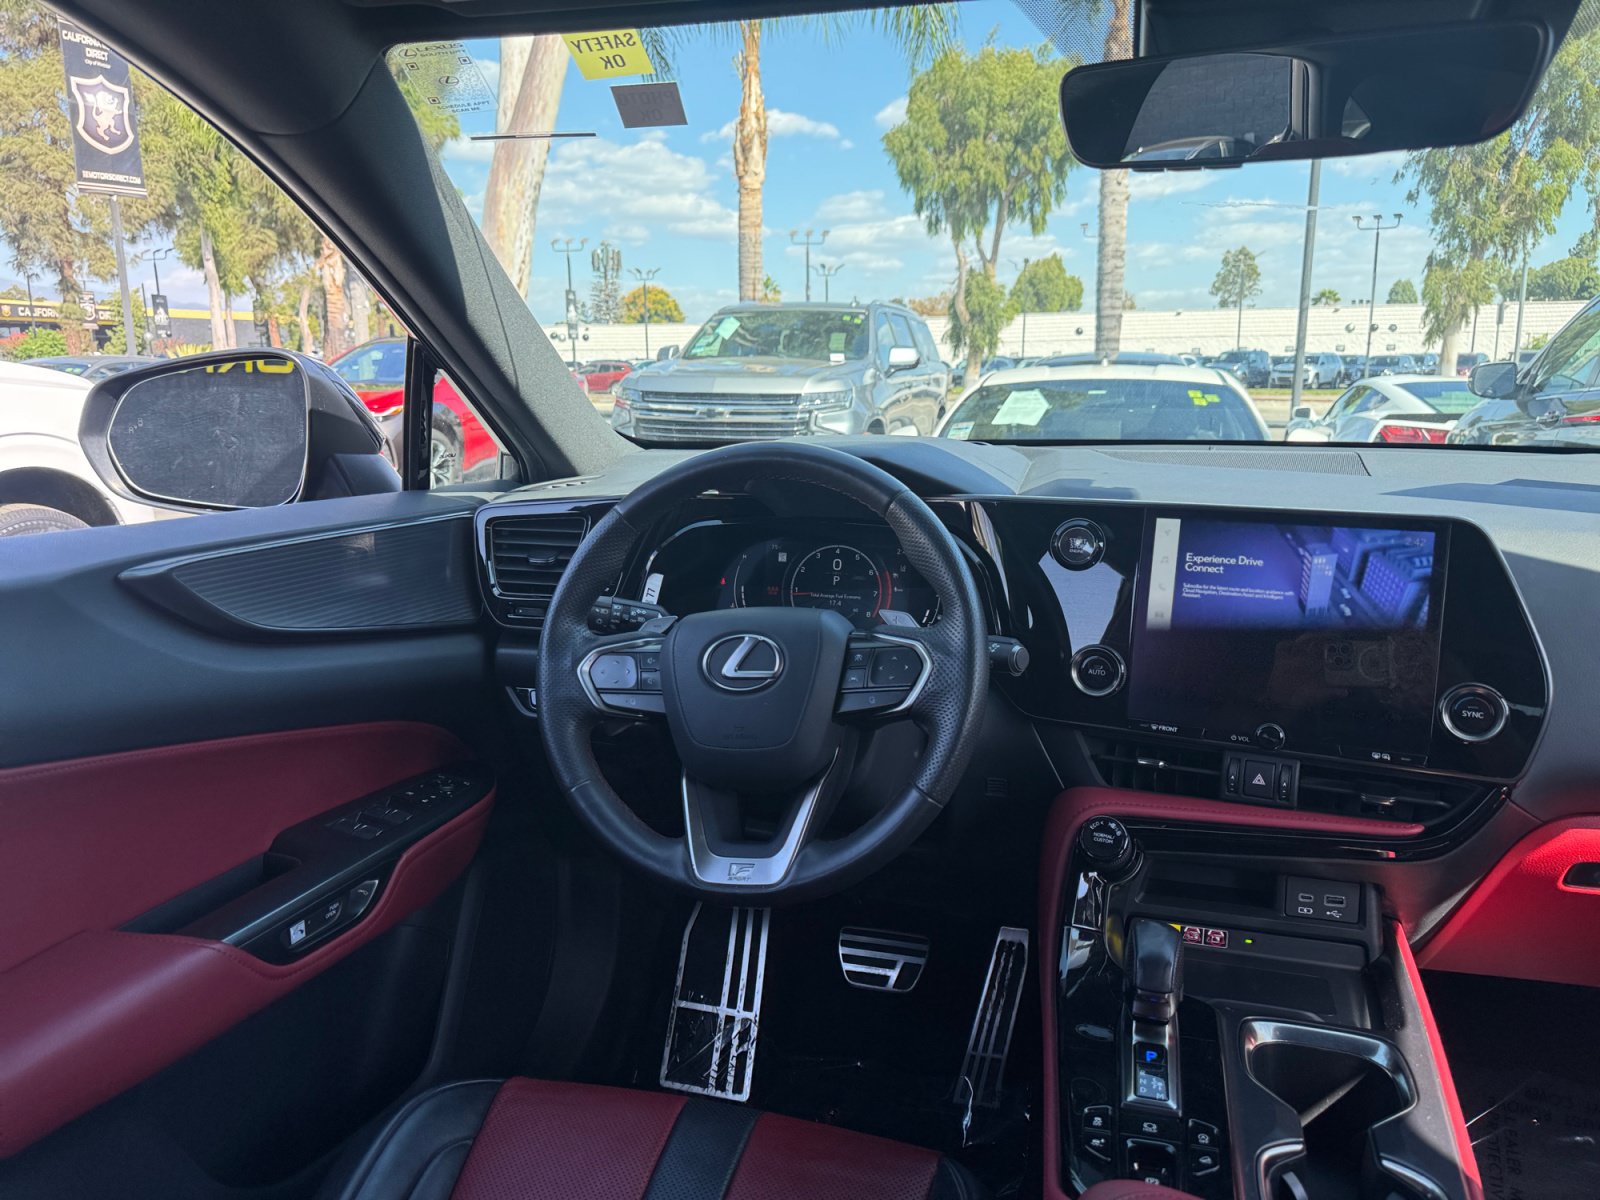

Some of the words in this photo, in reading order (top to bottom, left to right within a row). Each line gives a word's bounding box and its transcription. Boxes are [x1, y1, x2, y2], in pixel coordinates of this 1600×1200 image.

[415, 43, 464, 52] LEXUS
[85, 47, 109, 61] DIRECT
[832, 558, 842, 571] 0
[1186, 552, 1237, 564] Experience
[1238, 555, 1264, 567] Drive
[1185, 562, 1225, 574] Connect
[832, 575, 841, 586] P
[1088, 668, 1106, 676] AUTO
[1461, 709, 1485, 719] SYNC
[1089, 821, 1100, 830] ECO
[1146, 1050, 1157, 1062] P
[1156, 1092, 1165, 1100] M
